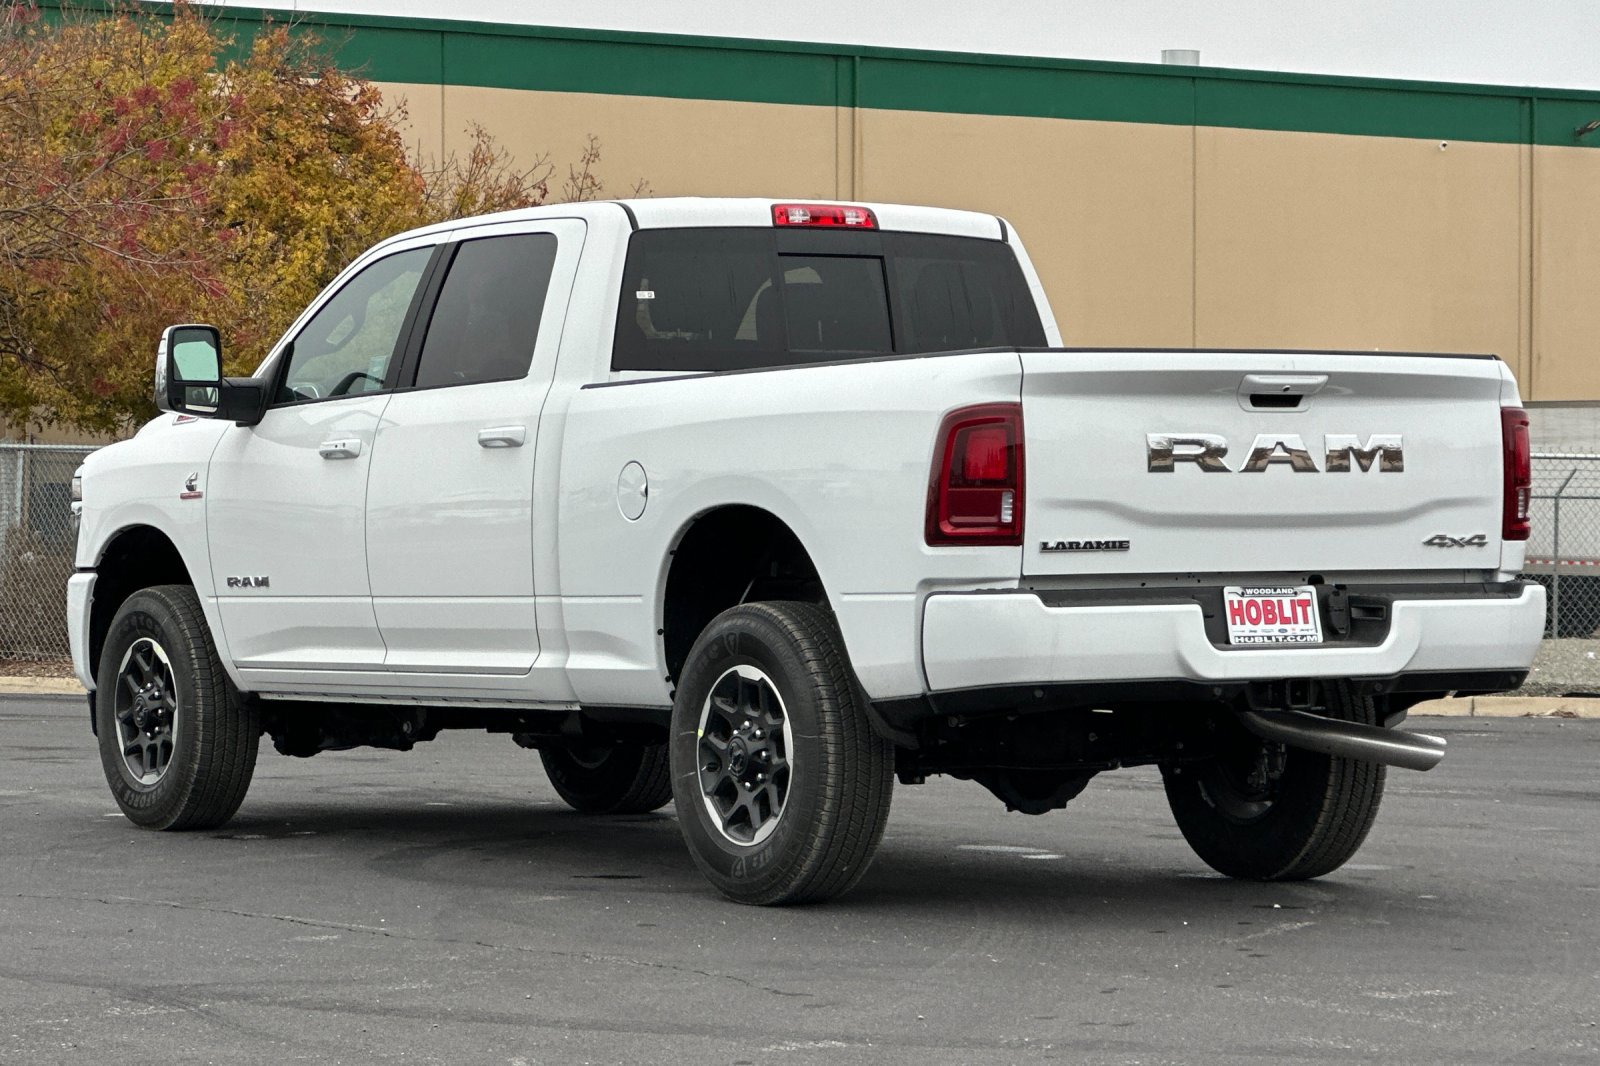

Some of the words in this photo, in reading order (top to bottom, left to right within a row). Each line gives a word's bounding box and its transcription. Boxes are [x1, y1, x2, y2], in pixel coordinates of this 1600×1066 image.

[1146, 433, 1404, 473] RAM
[1040, 540, 1130, 552] LARAMIE
[227, 576, 270, 588] RAM
[1228, 599, 1311, 625] HOBLIT
